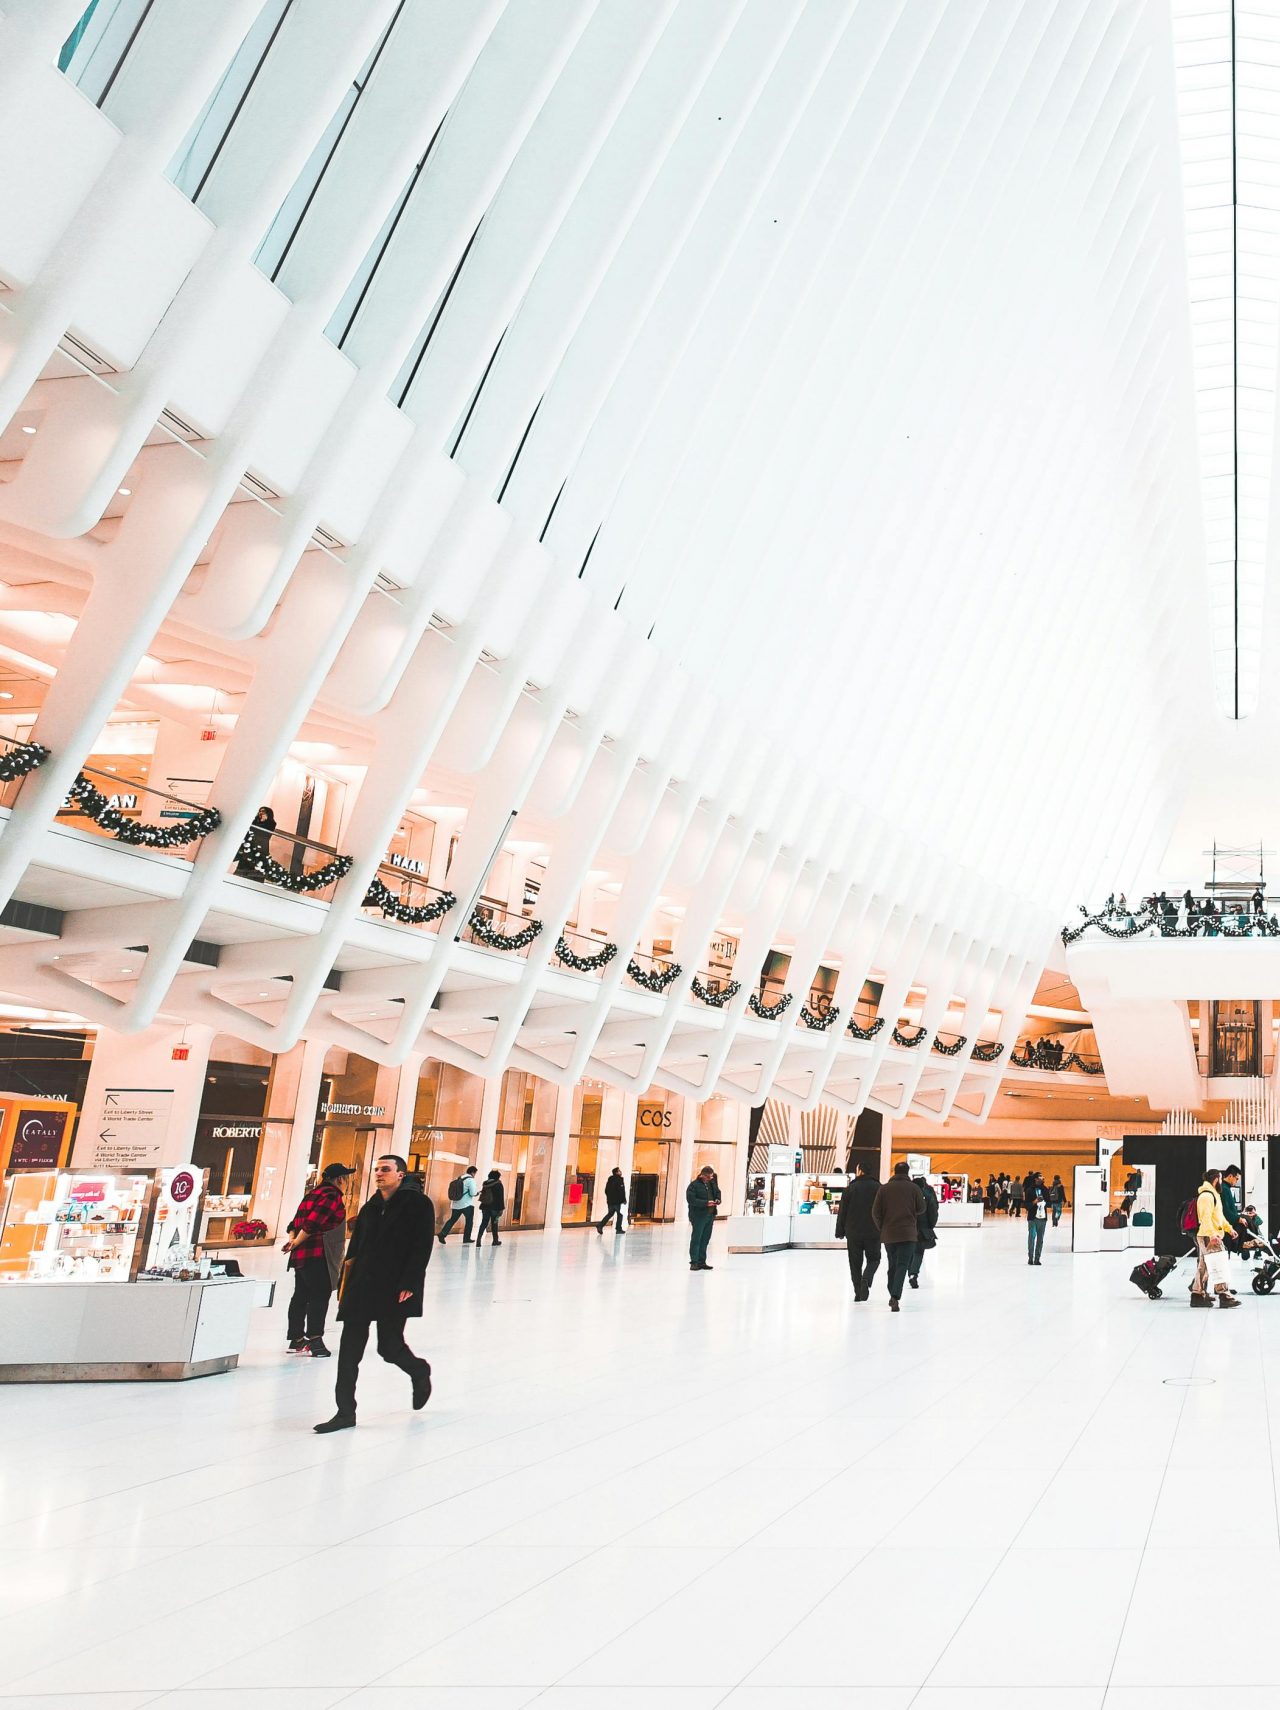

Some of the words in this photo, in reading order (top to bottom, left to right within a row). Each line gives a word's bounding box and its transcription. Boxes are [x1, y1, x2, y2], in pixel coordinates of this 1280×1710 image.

[391, 853, 425, 874] HAAN
[640, 1109, 672, 1127] COS
[212, 1127, 262, 1138] ROBERTO
